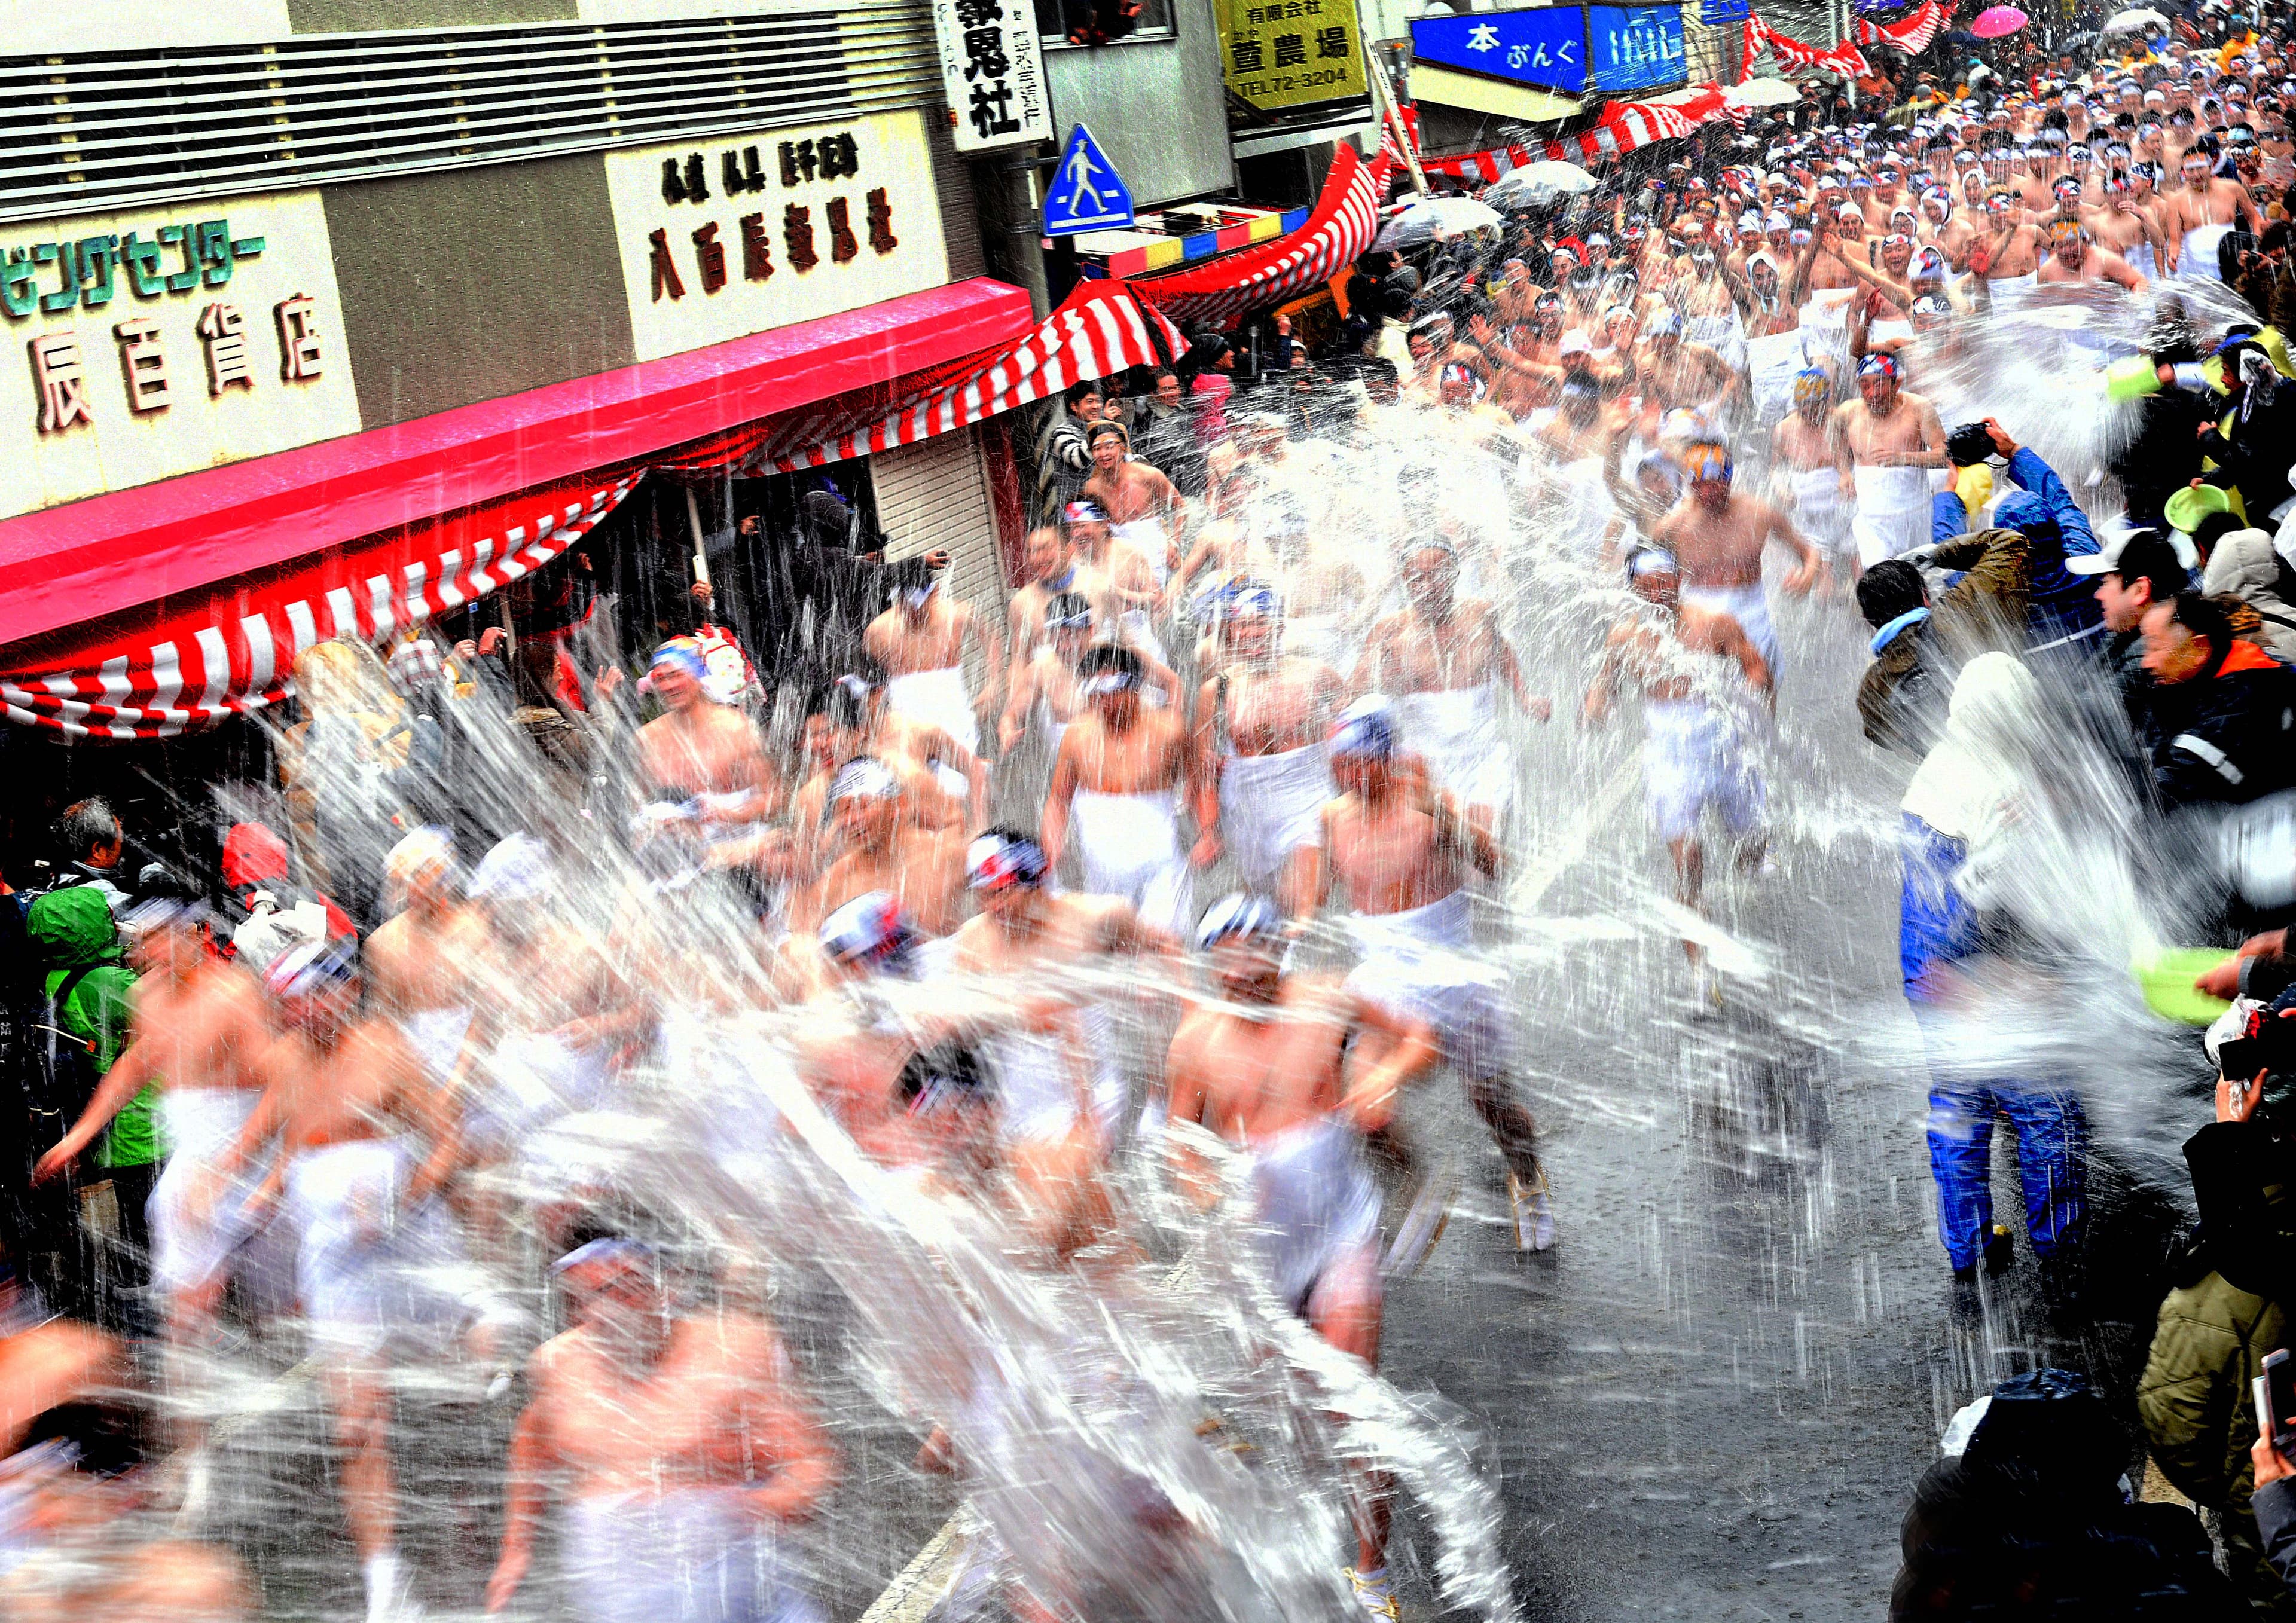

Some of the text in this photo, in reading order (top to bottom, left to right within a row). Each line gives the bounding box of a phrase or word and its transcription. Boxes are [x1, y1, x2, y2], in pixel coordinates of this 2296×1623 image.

[1246, 1, 1323, 25] 有限会社
[1466, 23, 1501, 52] 本
[1506, 39, 1577, 69] ぶんぐ
[29, 292, 325, 433] 辰百貨店
